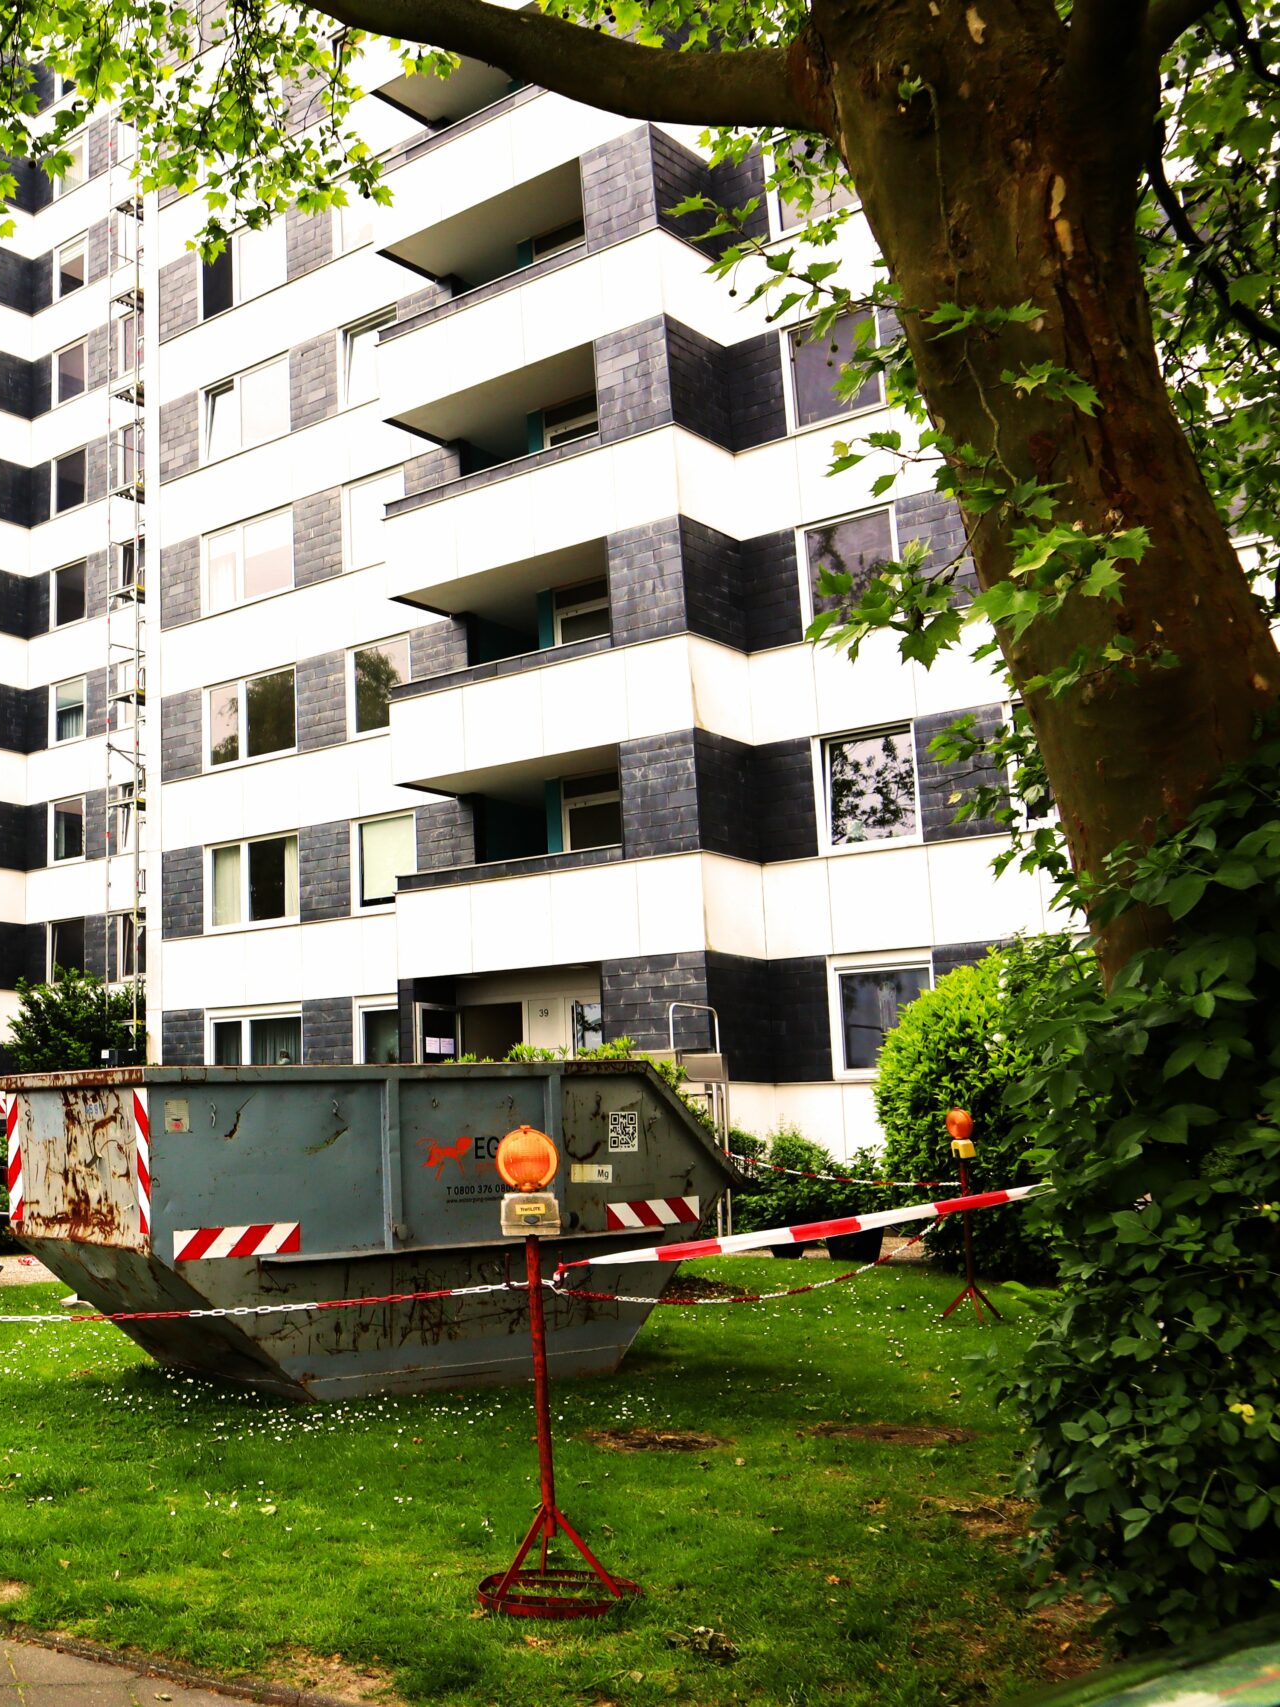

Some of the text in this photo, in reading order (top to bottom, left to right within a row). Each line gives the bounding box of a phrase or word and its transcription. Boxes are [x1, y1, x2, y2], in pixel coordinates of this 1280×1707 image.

[538, 1008, 550, 1018] 39
[473, 1136, 505, 1160] EG
[597, 1169, 609, 1180] Mg
[446, 1186, 452, 1195] T
[453, 1185, 476, 1196] 0800
[477, 1184, 493, 1194] 376
